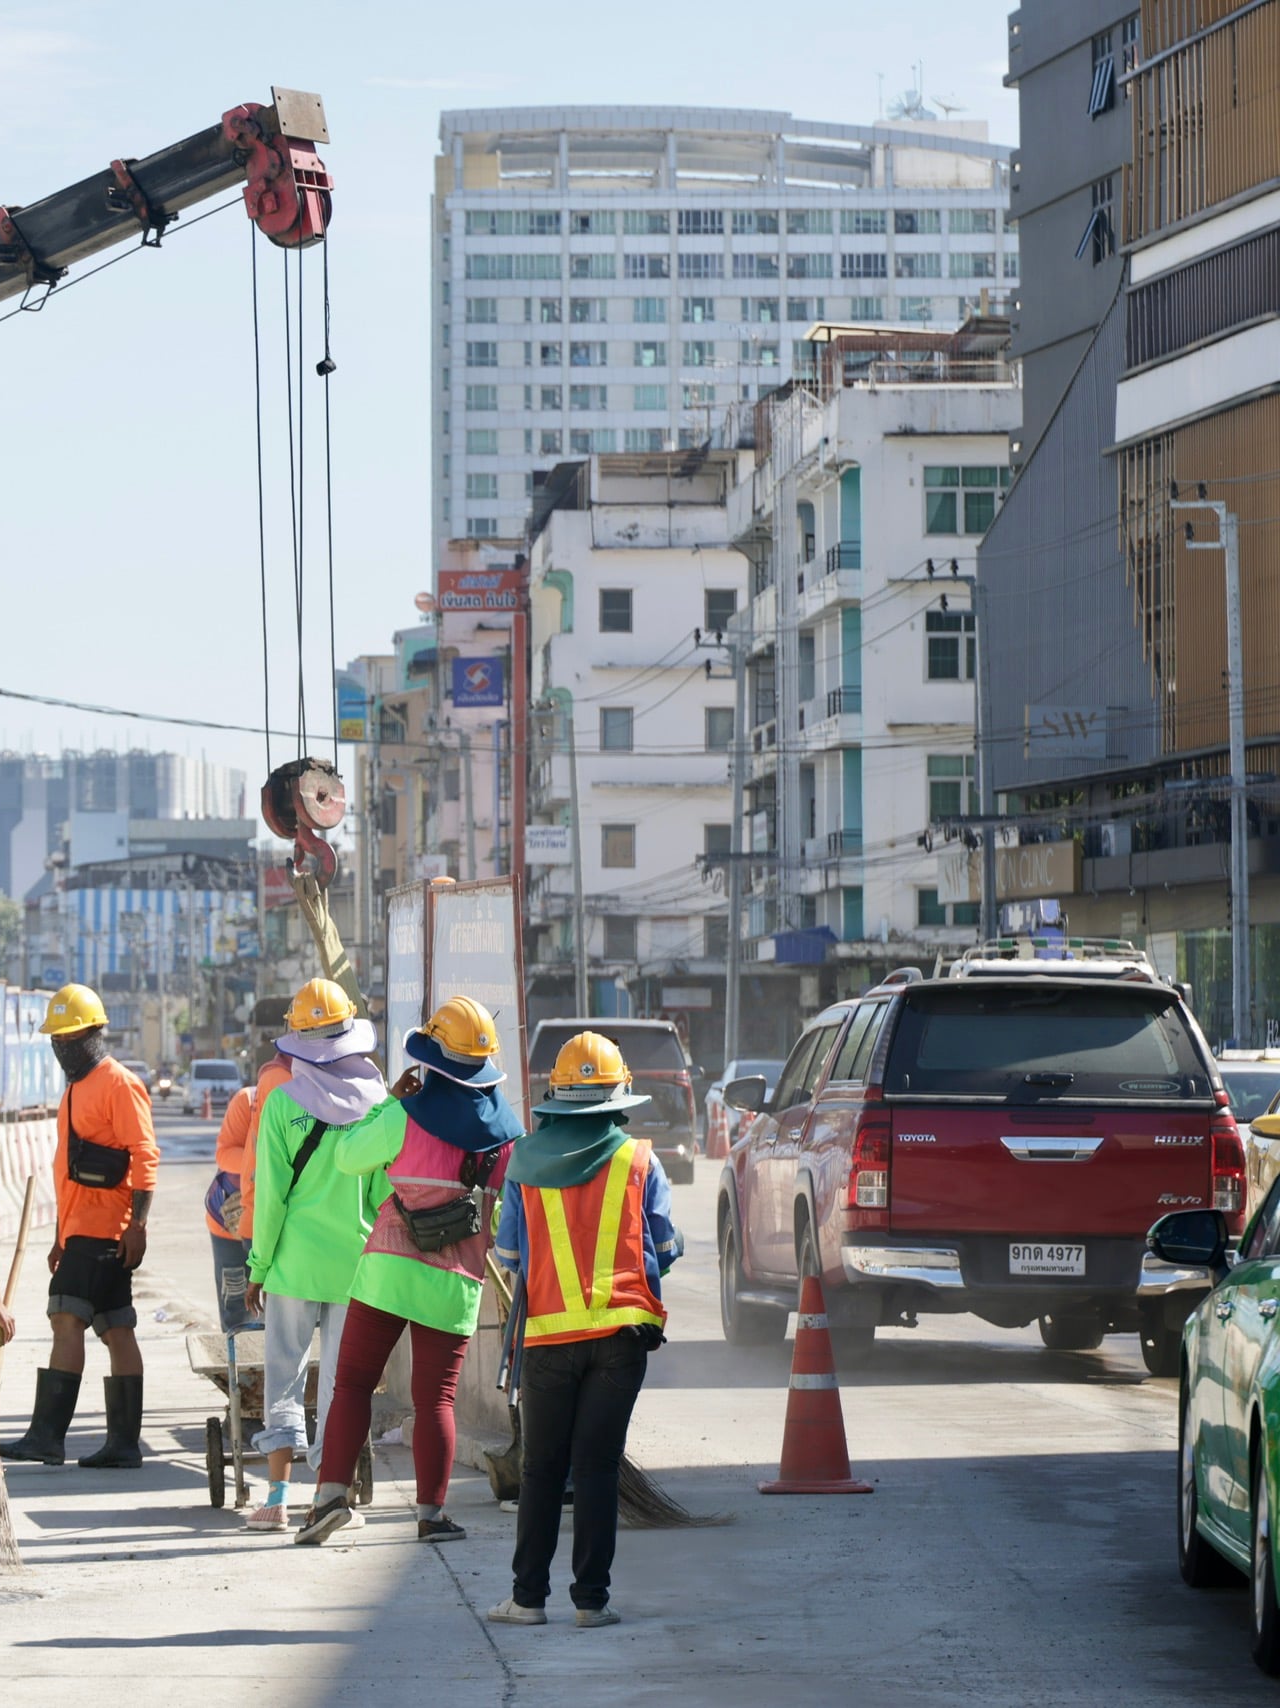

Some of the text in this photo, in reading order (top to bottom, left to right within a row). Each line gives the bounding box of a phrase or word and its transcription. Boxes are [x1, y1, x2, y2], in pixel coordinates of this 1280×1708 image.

[898, 1134, 937, 1142] TOYOTA
[1154, 1135, 1204, 1146] HILUX
[1012, 1246, 1082, 1261] 9กด 4977
